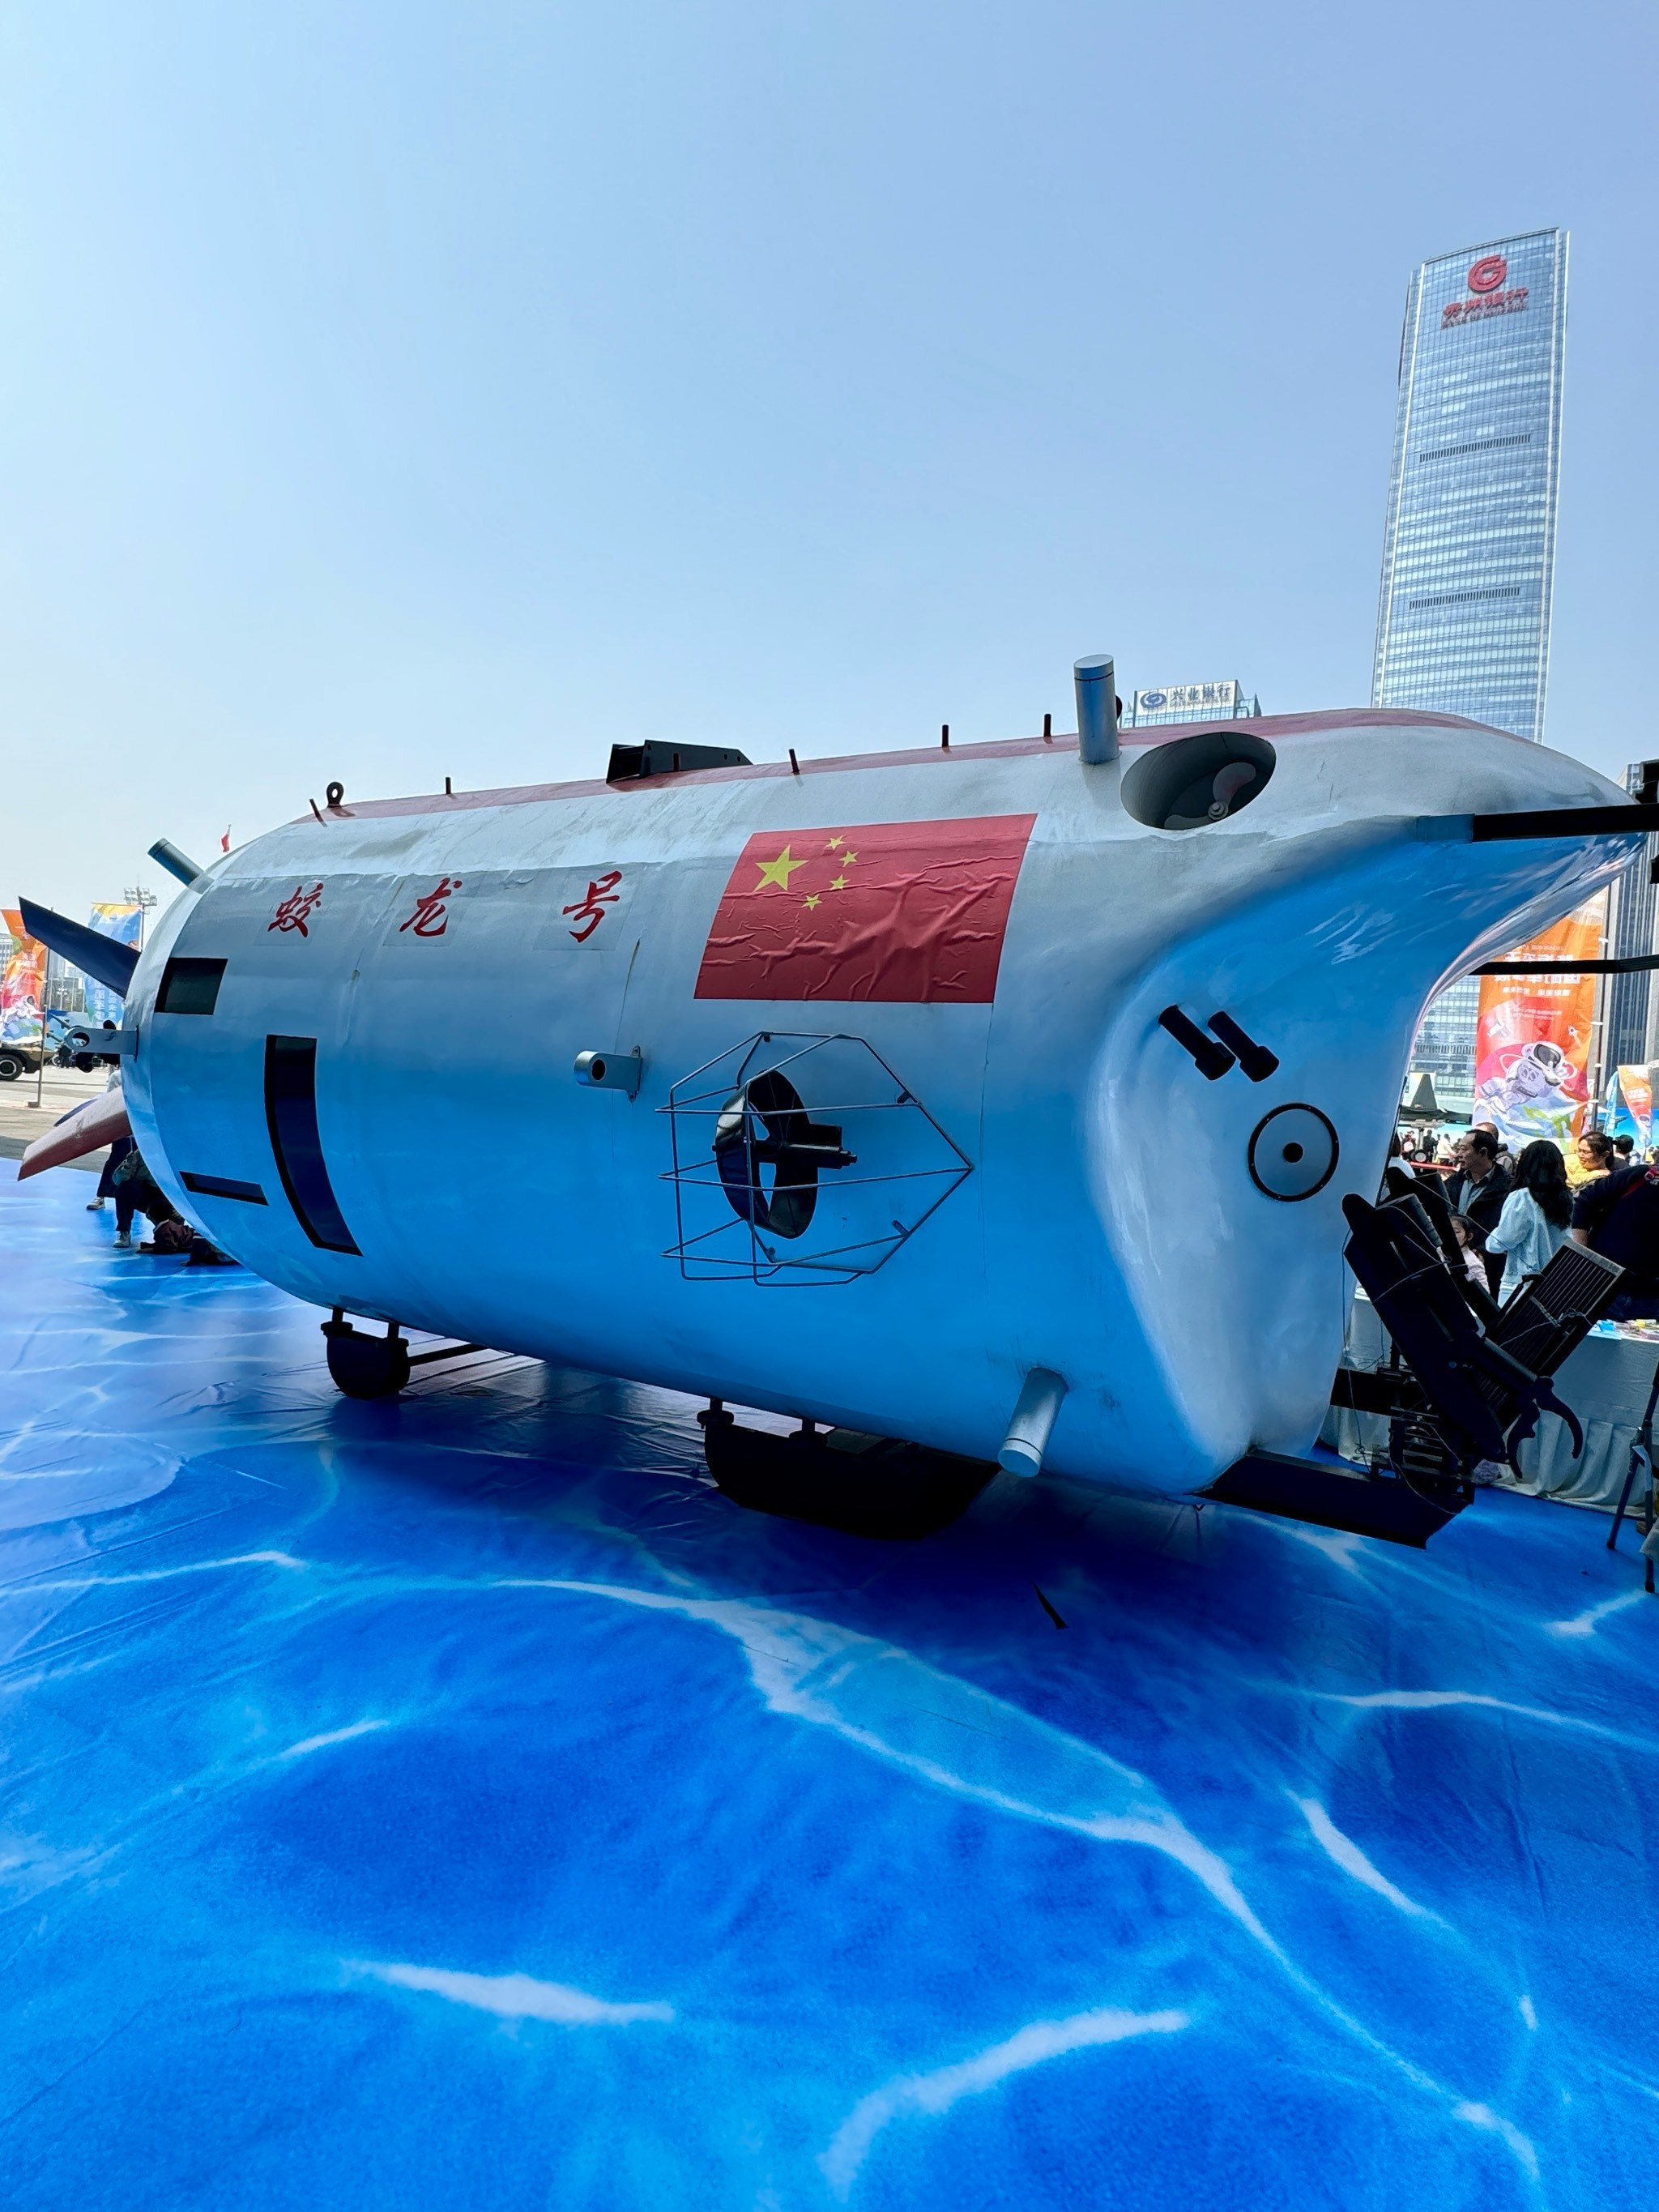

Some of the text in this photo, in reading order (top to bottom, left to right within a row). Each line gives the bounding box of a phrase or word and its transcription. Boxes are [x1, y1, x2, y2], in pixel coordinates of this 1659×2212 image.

[1171, 684, 1231, 701] 兴业银行
[268, 870, 623, 942] 蛟龙号
